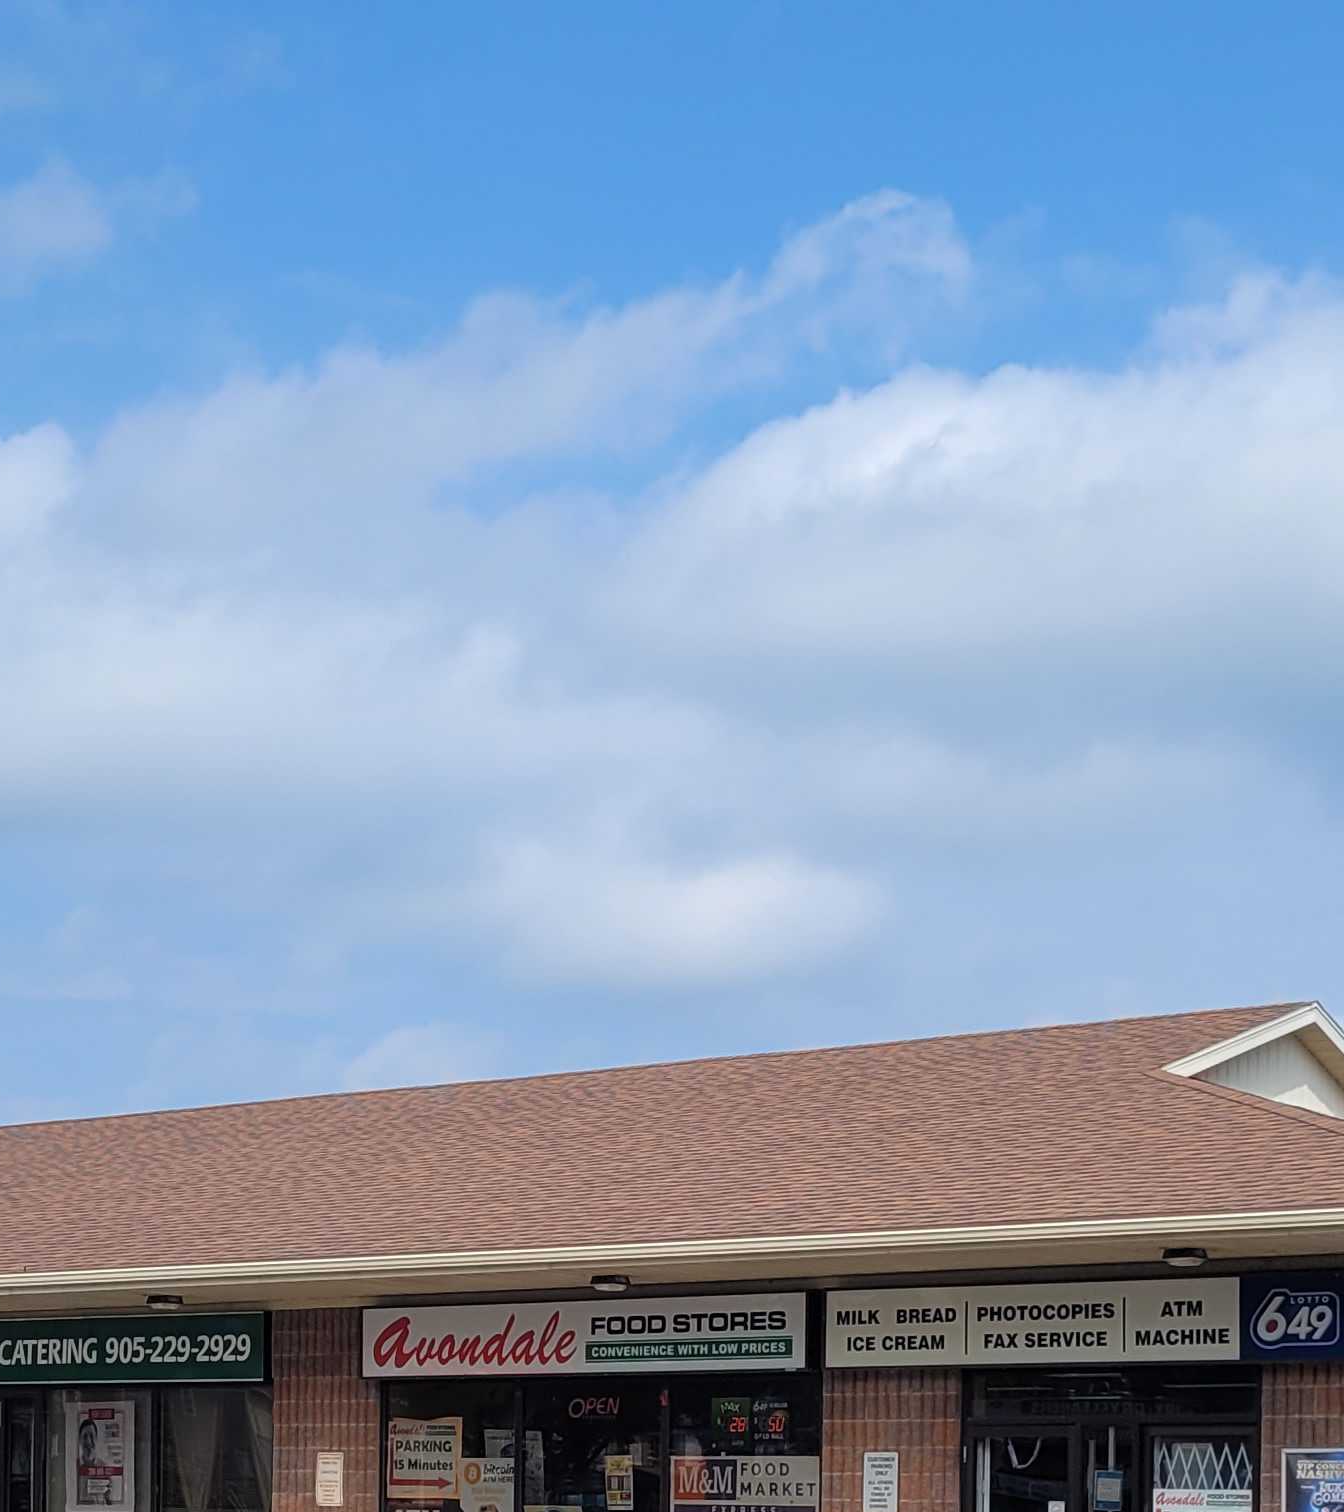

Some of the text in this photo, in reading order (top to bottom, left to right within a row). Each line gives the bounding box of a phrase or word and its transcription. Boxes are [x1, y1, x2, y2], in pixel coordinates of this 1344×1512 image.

[1160, 1300, 1203, 1318] ATM
[1290, 1296, 1329, 1305] LOTTO
[836, 1308, 957, 1325] MILK BREAD
[976, 1303, 1115, 1322] PHOTOCOPIES
[590, 1310, 787, 1336] FOOD STORES
[373, 1310, 577, 1368] Avondale
[846, 1335, 945, 1352] ICE CREAM
[983, 1331, 1108, 1349] FAX SERVICE
[1135, 1328, 1231, 1347] MACHINE
[105, 1333, 252, 1364] 905-229-2929
[591, 1340, 787, 1358] CONVENIENCE WITH LOW PRICES
[568, 1397, 621, 1418] OPEN
[395, 1439, 453, 1453] PARKING
[394, 1458, 454, 1471] 15 Minutes
[483, 1463, 515, 1475] bitcoin
[740, 1463, 790, 1476] FOOD
[678, 1465, 734, 1495] M&M
[740, 1482, 817, 1497] MARKET
